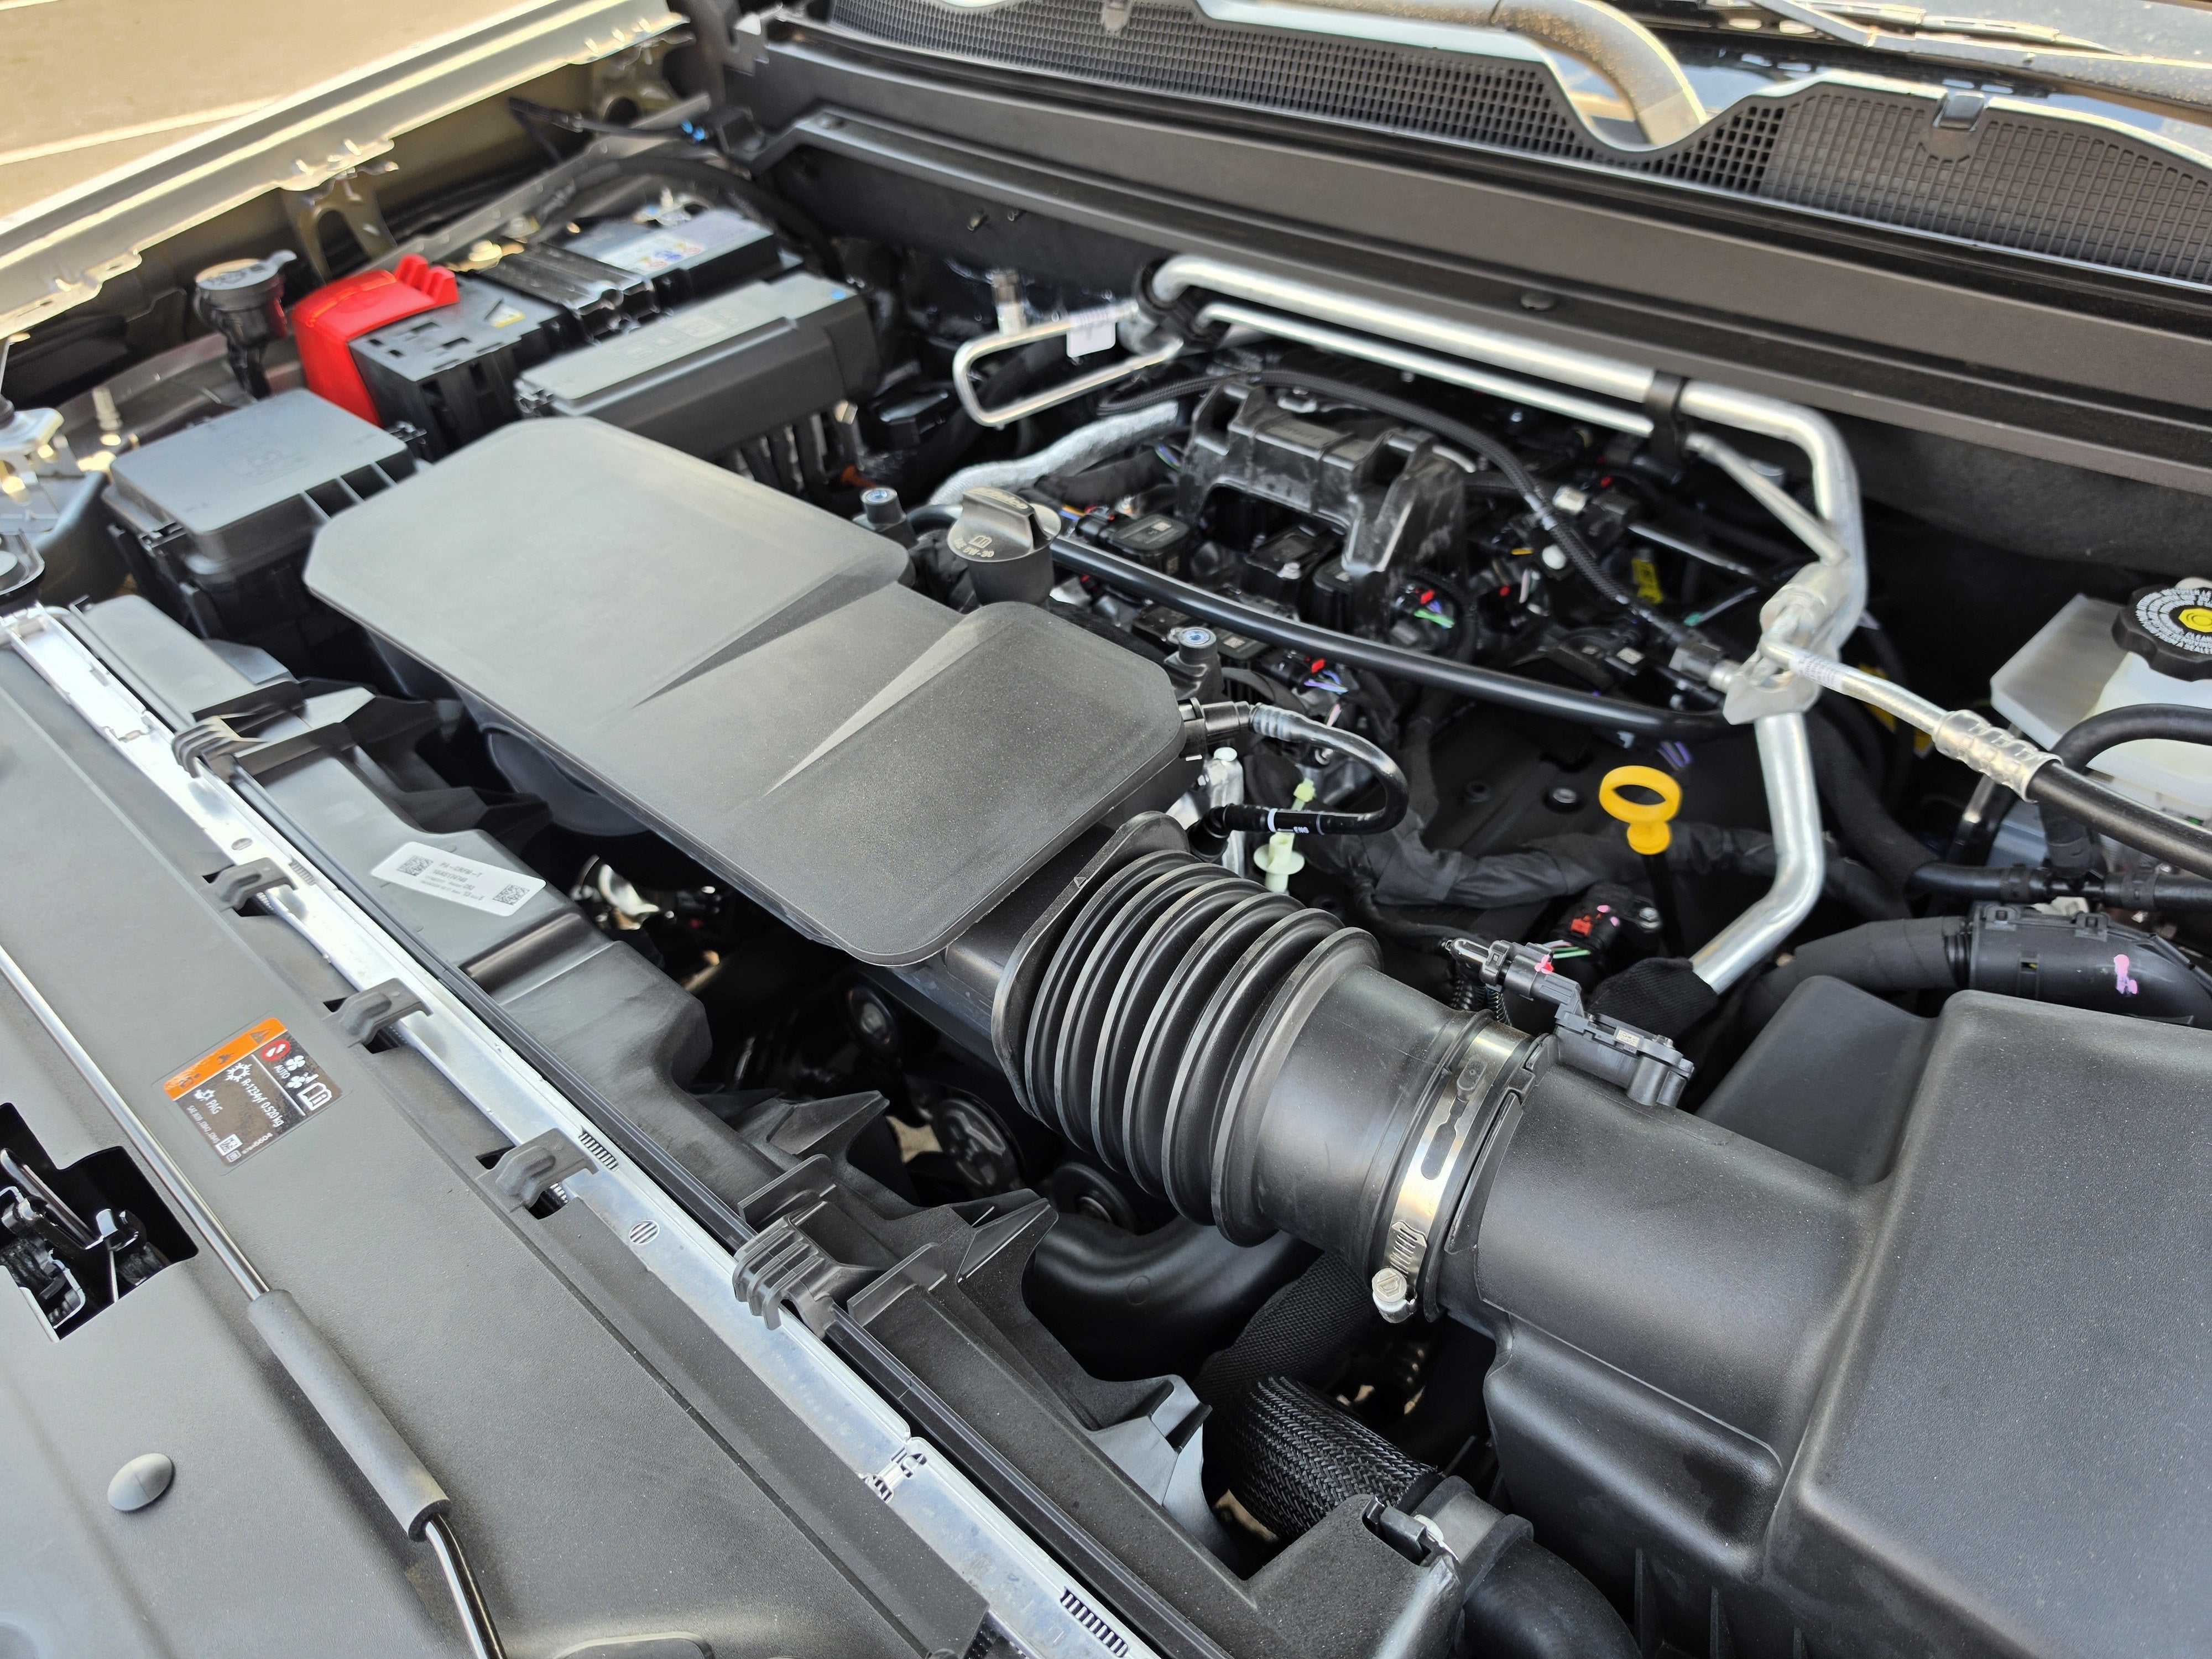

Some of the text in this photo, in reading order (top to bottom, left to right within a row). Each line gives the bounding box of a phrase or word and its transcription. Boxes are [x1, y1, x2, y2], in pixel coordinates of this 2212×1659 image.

[274, 1065, 290, 1079] AUTO
[206, 1099, 223, 1114] PAG
[241, 1078, 268, 1103] R-1234yf
[272, 1115, 284, 1128] kg
